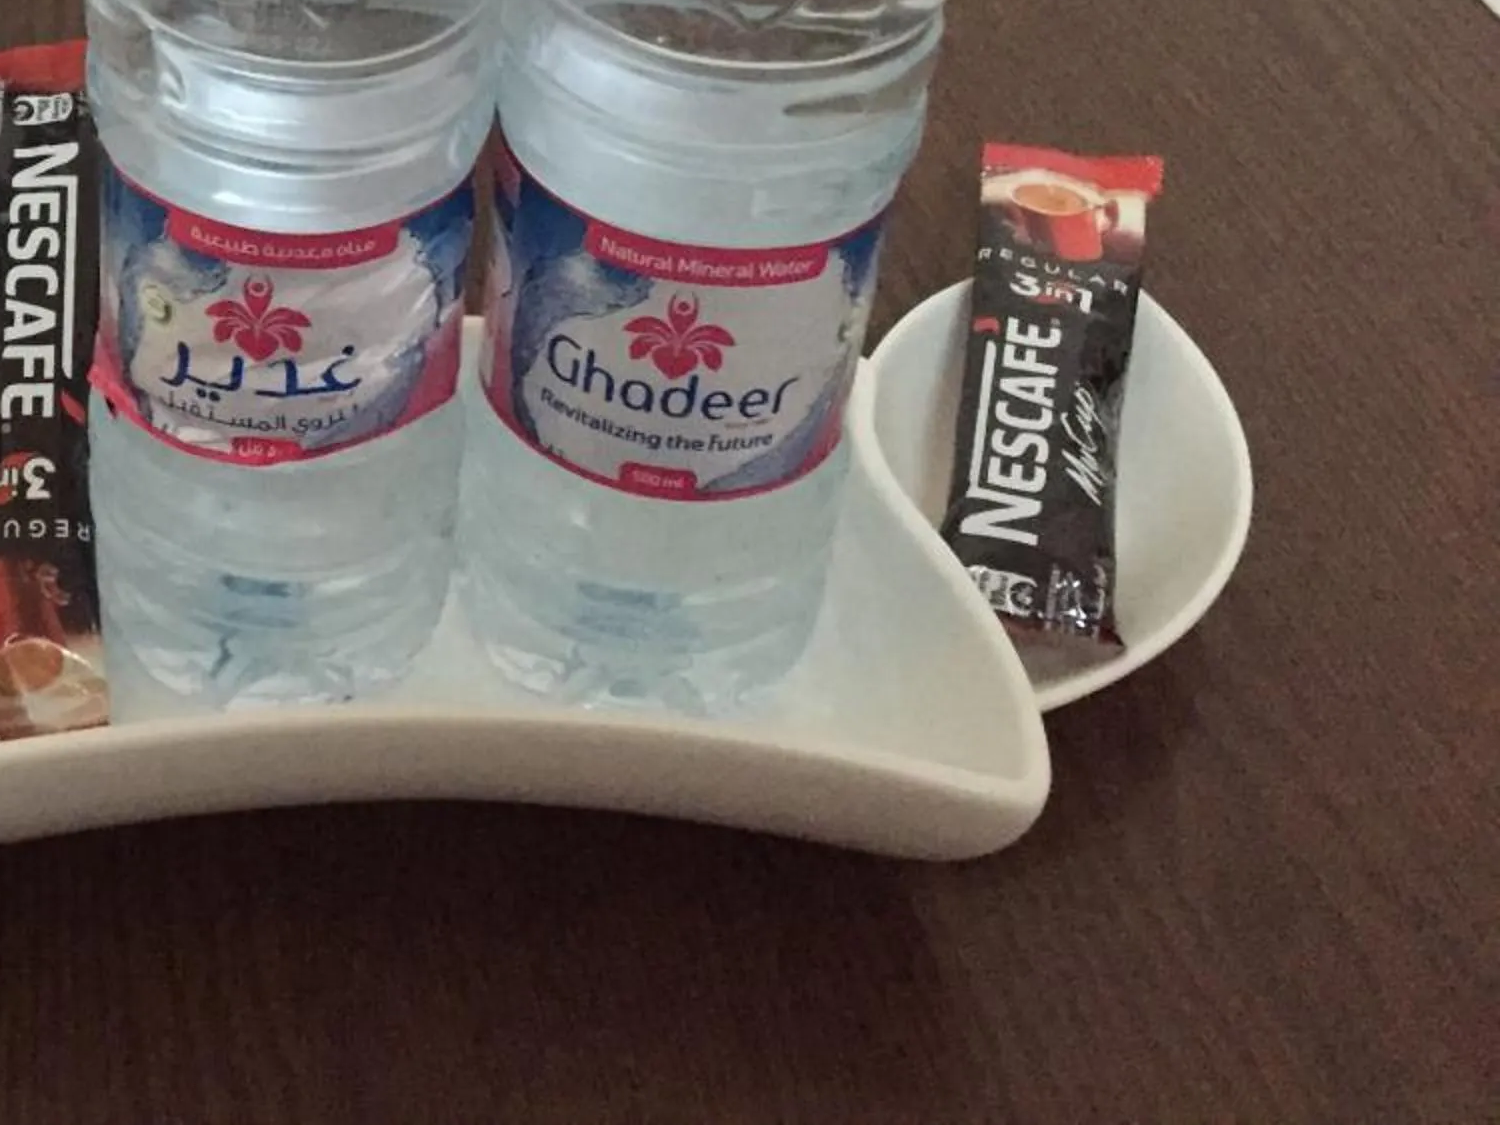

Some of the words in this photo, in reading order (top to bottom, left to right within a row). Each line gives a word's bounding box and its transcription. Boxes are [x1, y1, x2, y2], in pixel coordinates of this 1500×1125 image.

[600, 236, 673, 273] Natural
[677, 257, 756, 280] Mineral
[757, 257, 815, 279] Water
[977, 246, 1129, 297] REGULAR
[159, 340, 363, 403] غدير
[547, 333, 800, 421] Ghadeer
[540, 386, 661, 451] Revitalizing
[665, 433, 706, 453] the
[707, 432, 775, 453] Future
[1059, 383, 1106, 457] Cup
